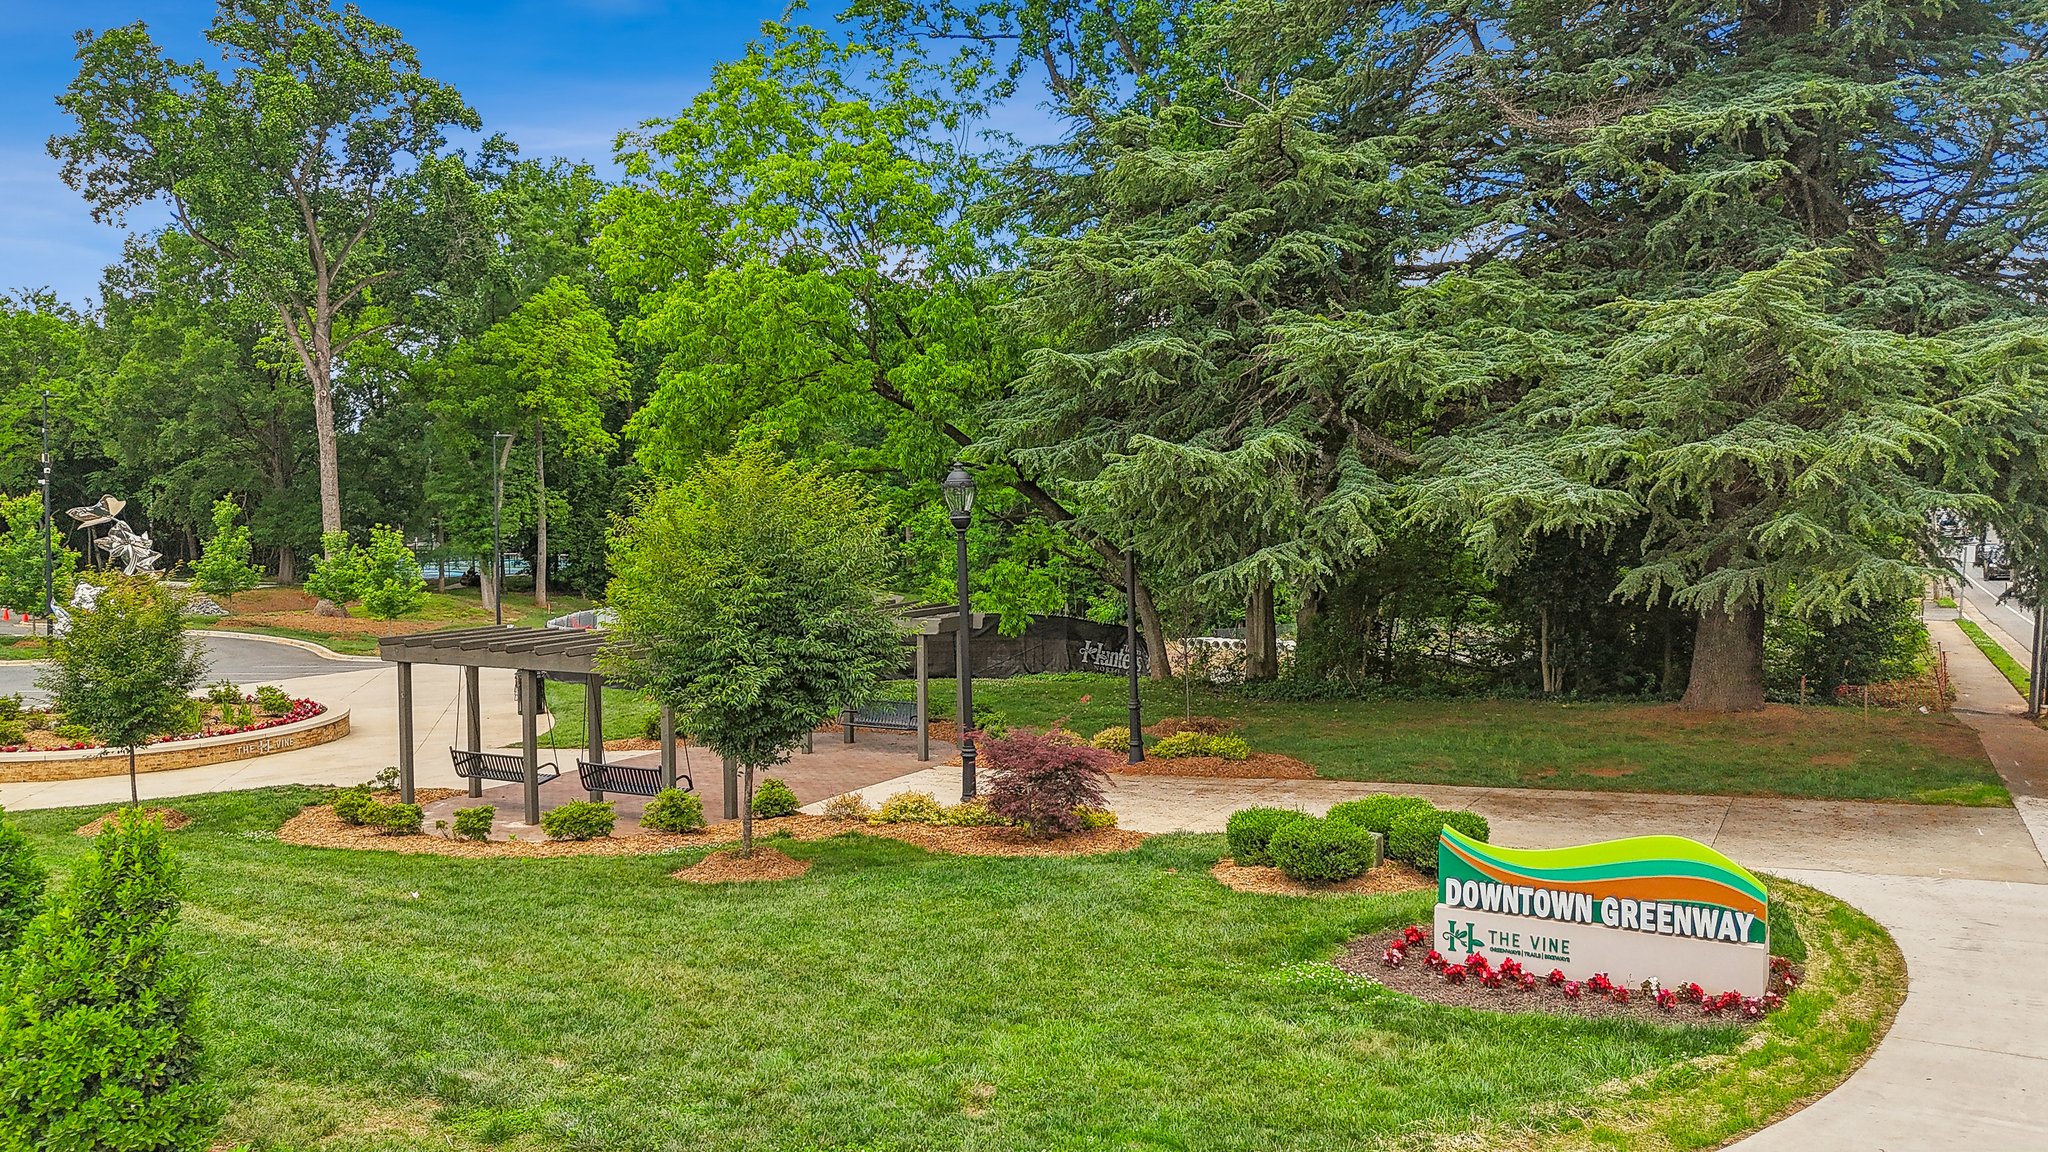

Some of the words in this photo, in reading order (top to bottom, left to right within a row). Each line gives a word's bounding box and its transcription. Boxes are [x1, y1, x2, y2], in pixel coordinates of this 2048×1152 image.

[237, 745, 255, 755] THE
[275, 738, 294, 749] VINE
[1444, 877, 1594, 924] DOWNTOWN
[1600, 896, 1756, 943] GREENWAY
[1488, 929, 1521, 948] THE
[1530, 935, 1570, 954] VINE
